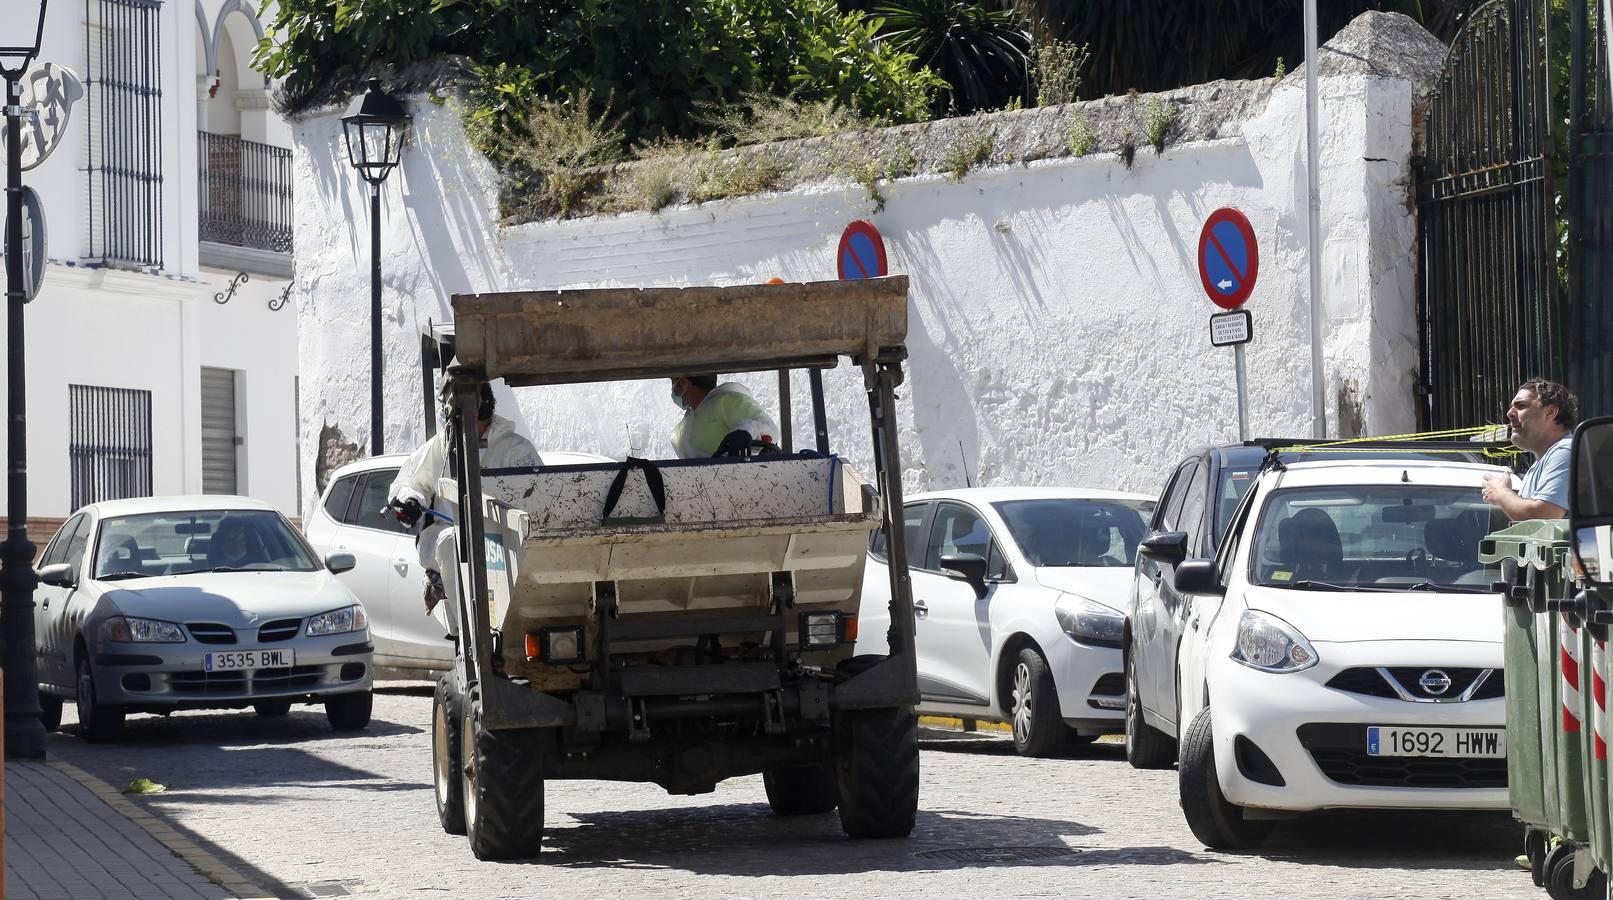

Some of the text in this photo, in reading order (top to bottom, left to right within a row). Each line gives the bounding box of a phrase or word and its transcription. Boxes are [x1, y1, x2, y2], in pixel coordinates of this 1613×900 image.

[217, 651, 289, 668] 3535 BWL
[1390, 731, 1498, 754] 1692 HWW
